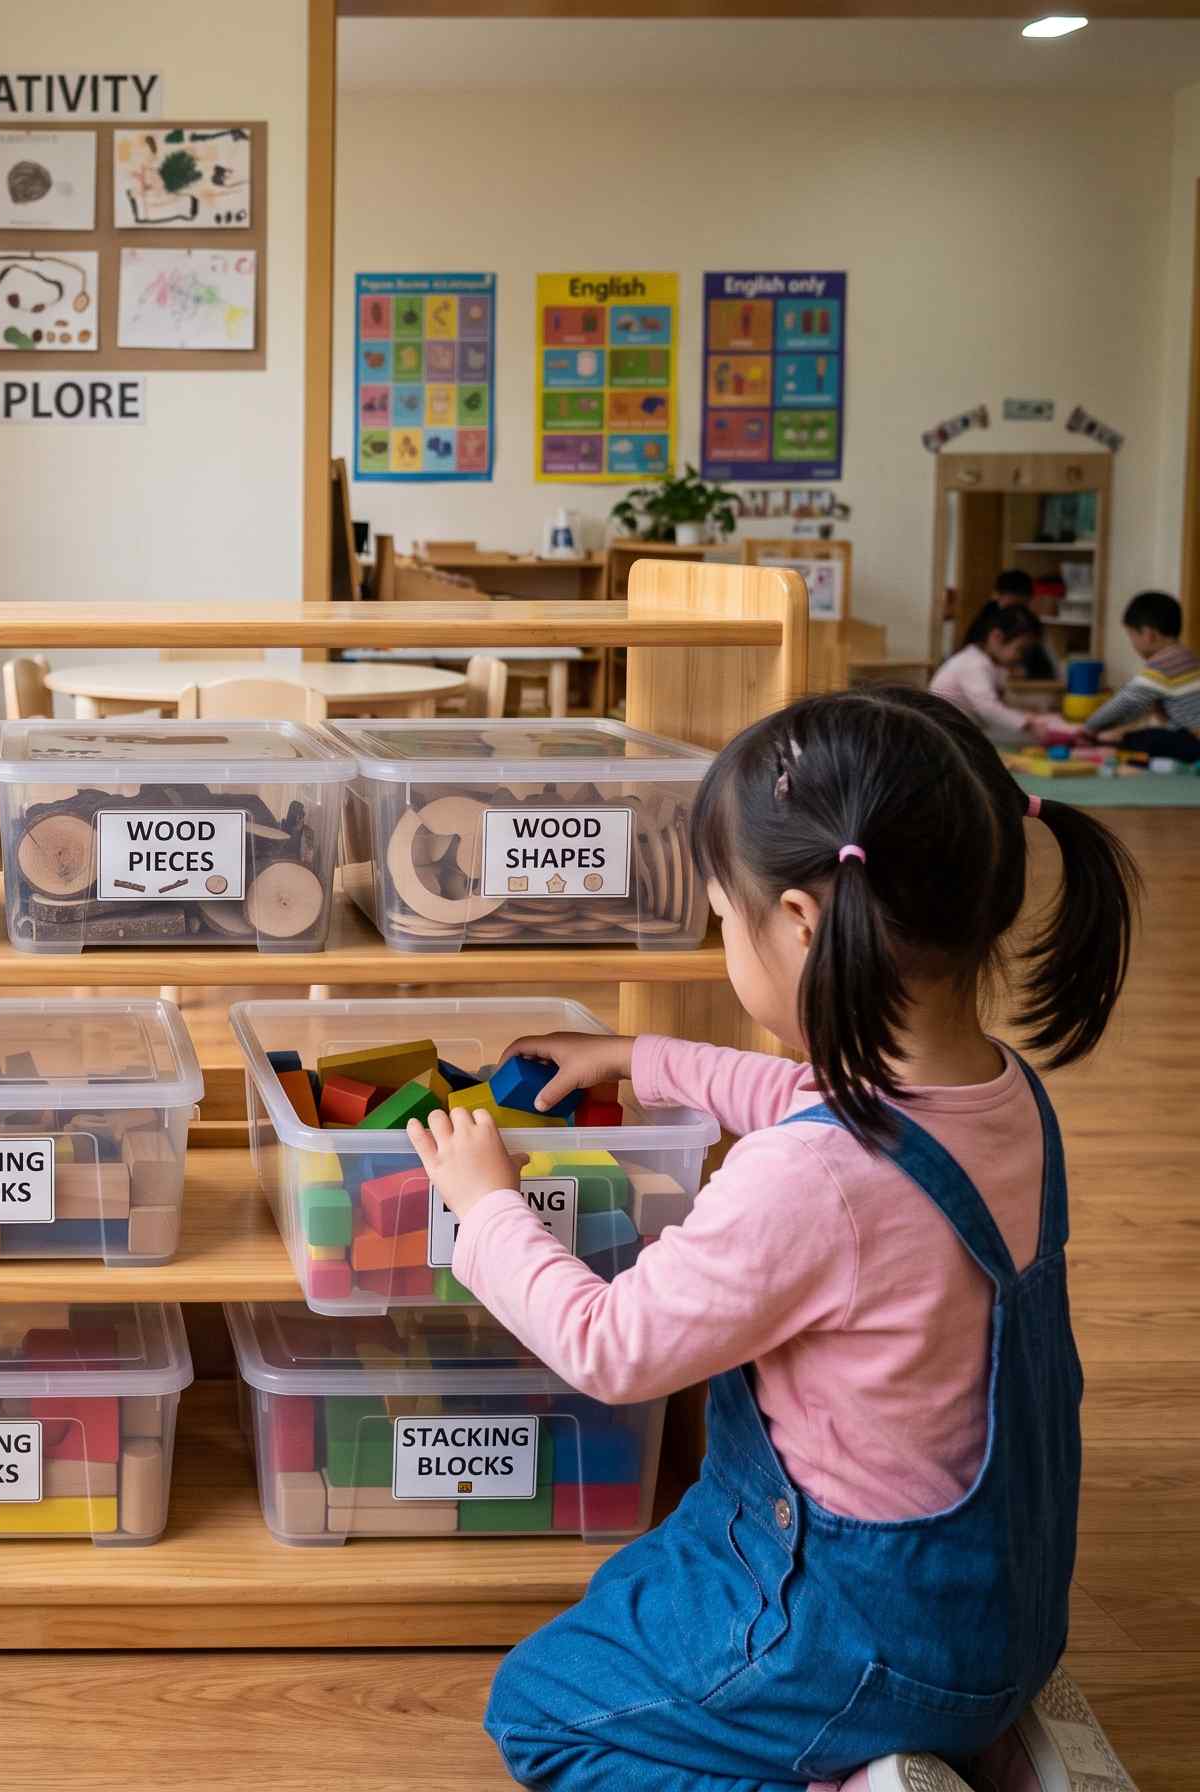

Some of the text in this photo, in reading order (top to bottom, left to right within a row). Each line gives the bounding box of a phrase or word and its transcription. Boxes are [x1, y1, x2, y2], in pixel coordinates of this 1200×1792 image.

[569, 277, 646, 301] English
[724, 276, 826, 299] English only
[126, 820, 216, 842] WOOD
[512, 817, 602, 839] WOOD
[129, 851, 214, 872] PIECES
[505, 847, 606, 869] SHAPES
[402, 1426, 529, 1448] STACKING
[417, 1455, 514, 1476] BLOCKS
